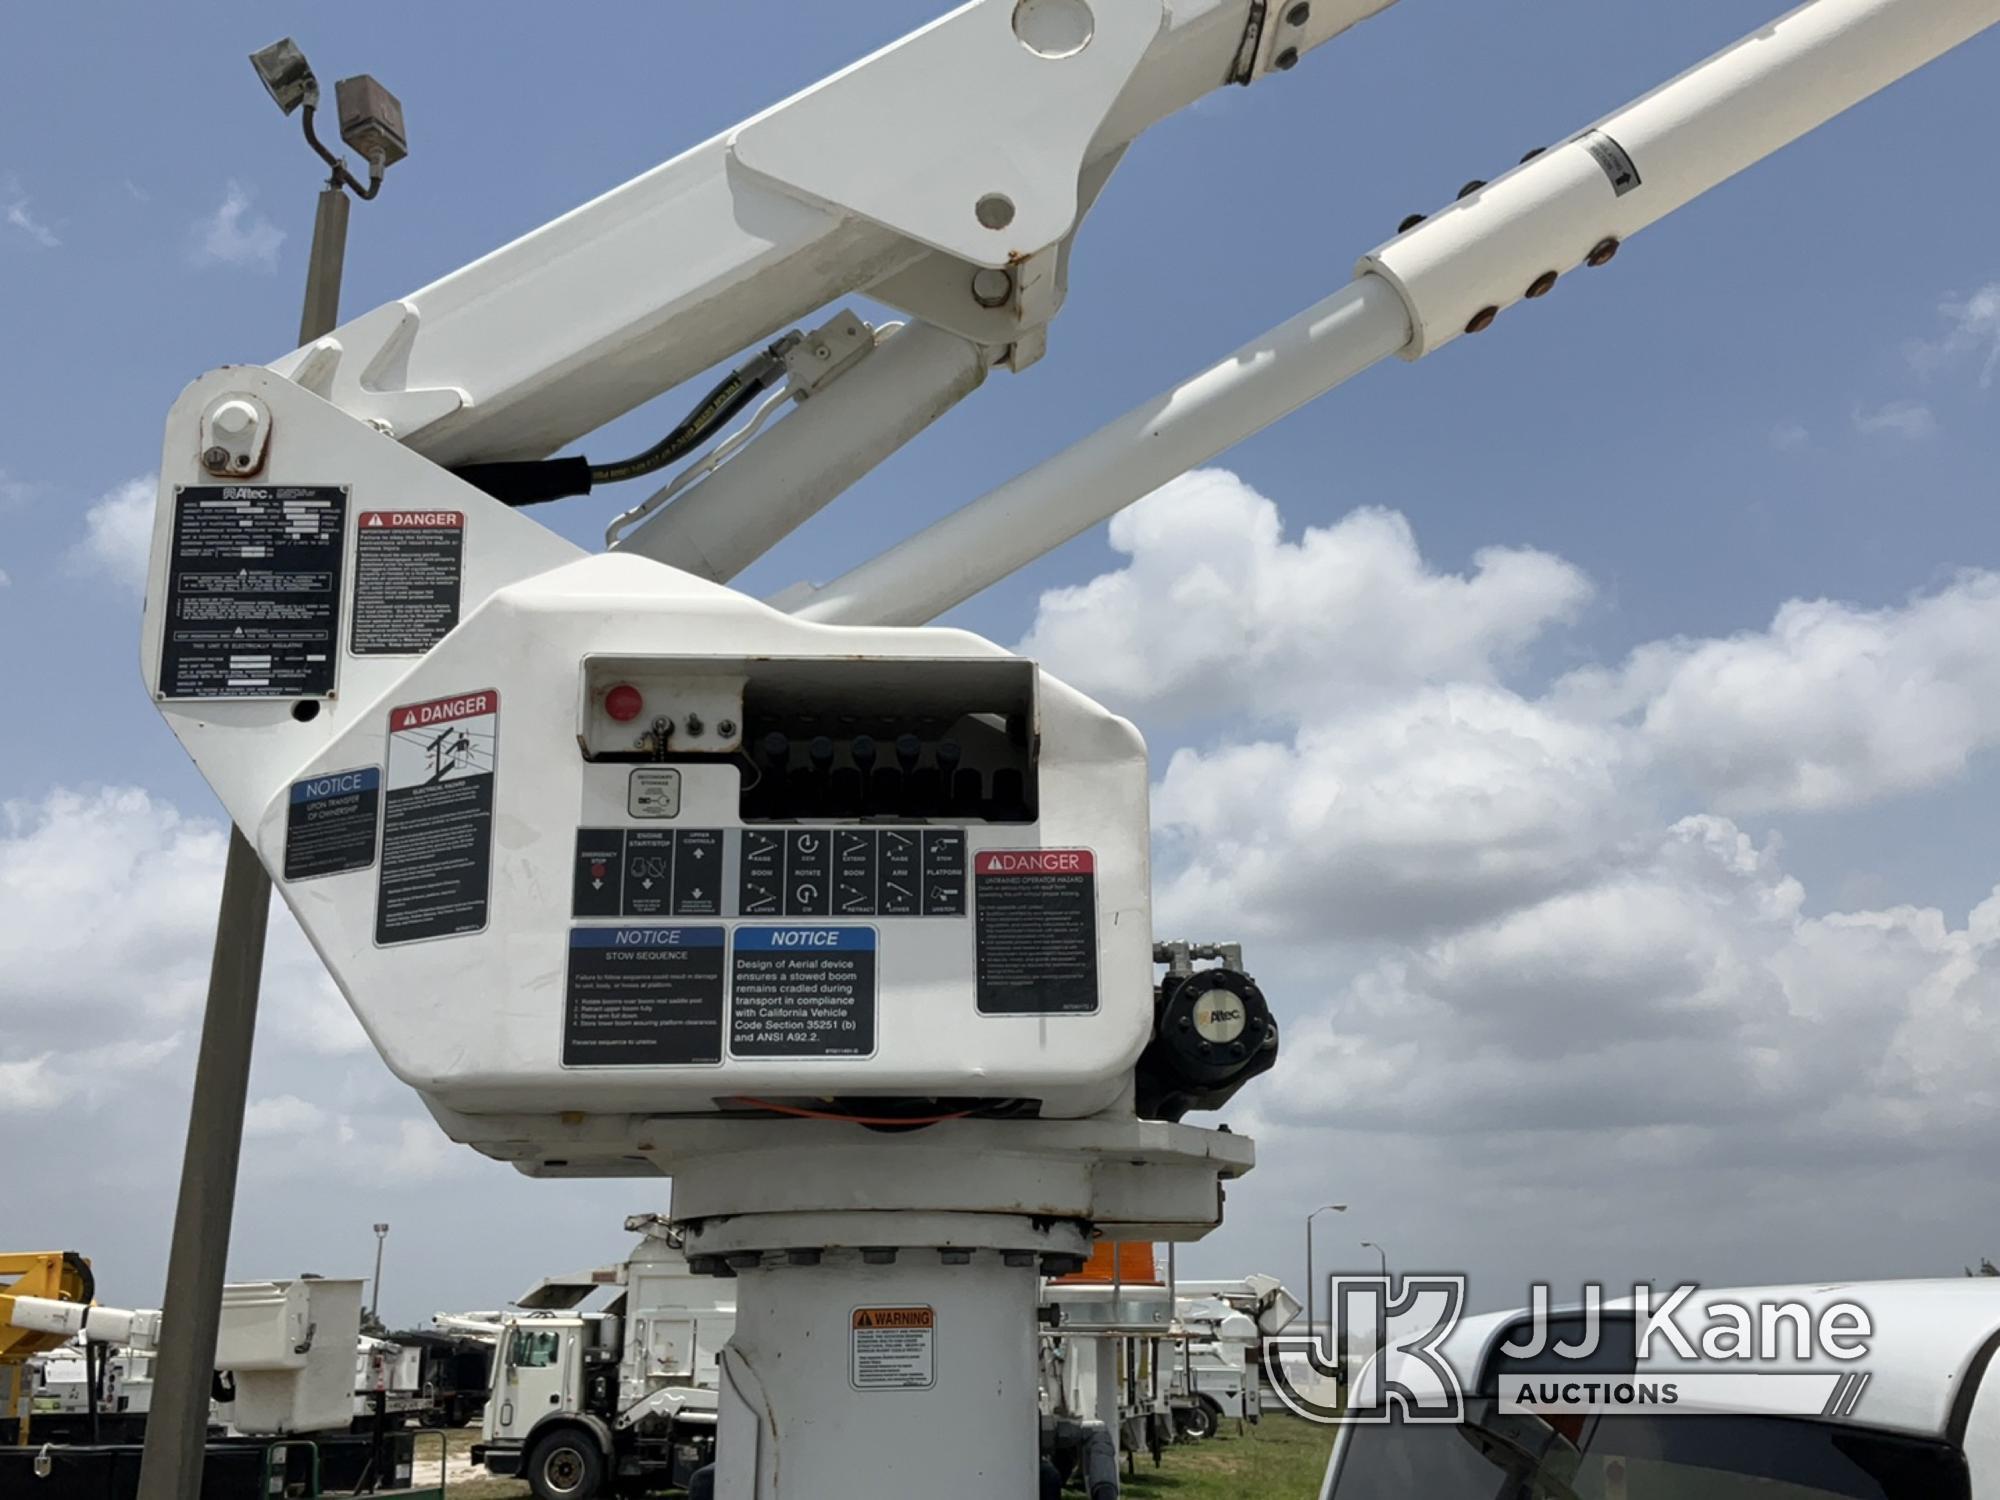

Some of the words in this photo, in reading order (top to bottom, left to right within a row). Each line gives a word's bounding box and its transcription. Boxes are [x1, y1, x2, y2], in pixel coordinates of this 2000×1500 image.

[393, 514, 456, 525] DANGER
[421, 696, 486, 723] DANGER
[306, 774, 362, 798] NOTICE
[1004, 855, 1079, 870] DANGER
[615, 930, 680, 944] NOTICE
[771, 932, 839, 945] NOTICE
[606, 952, 634, 960] STOW
[637, 952, 688, 960] SEQUENCE
[737, 960, 772, 970] Design
[775, 960, 786, 969] of
[788, 960, 818, 969] Aerial
[820, 960, 854, 969] device
[790, 972, 825, 980] stowed
[828, 972, 857, 980] boom
[736, 985, 777, 993] remains
[780, 984, 818, 993] cradled
[820, 984, 852, 994] during
[736, 996, 782, 1006] transport
[784, 996, 794, 1004] in
[797, 996, 854, 1006] compliance
[736, 1008, 756, 1017] with
[759, 1008, 808, 1017] California
[811, 1008, 847, 1017] Vehicle
[1211, 1009, 1240, 1023] Altec
[735, 1021, 762, 1029] Code
[766, 1021, 804, 1029] Section
[806, 1021, 837, 1029] 35251
[842, 1021, 856, 1030] (b)
[734, 1033, 753, 1042] and
[756, 1033, 783, 1042] ANSI
[787, 1033, 820, 1042] A92.2.
[875, 1312, 929, 1325] WARNING
